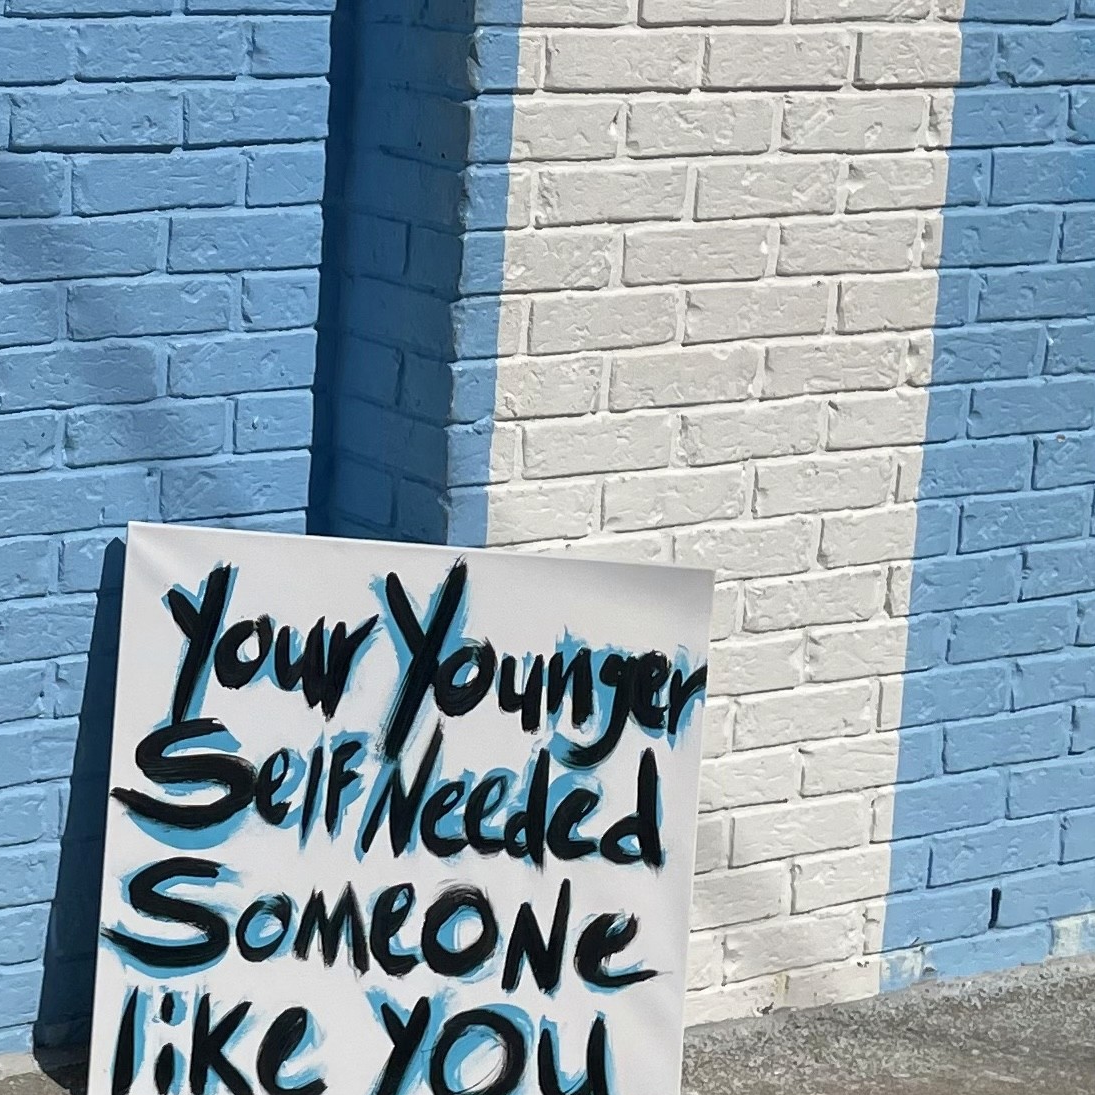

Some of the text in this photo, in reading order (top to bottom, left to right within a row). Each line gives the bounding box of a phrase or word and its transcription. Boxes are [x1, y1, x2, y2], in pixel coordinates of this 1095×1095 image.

[165, 552, 708, 769] Your Younger
[359, 720, 667, 874] Needed
